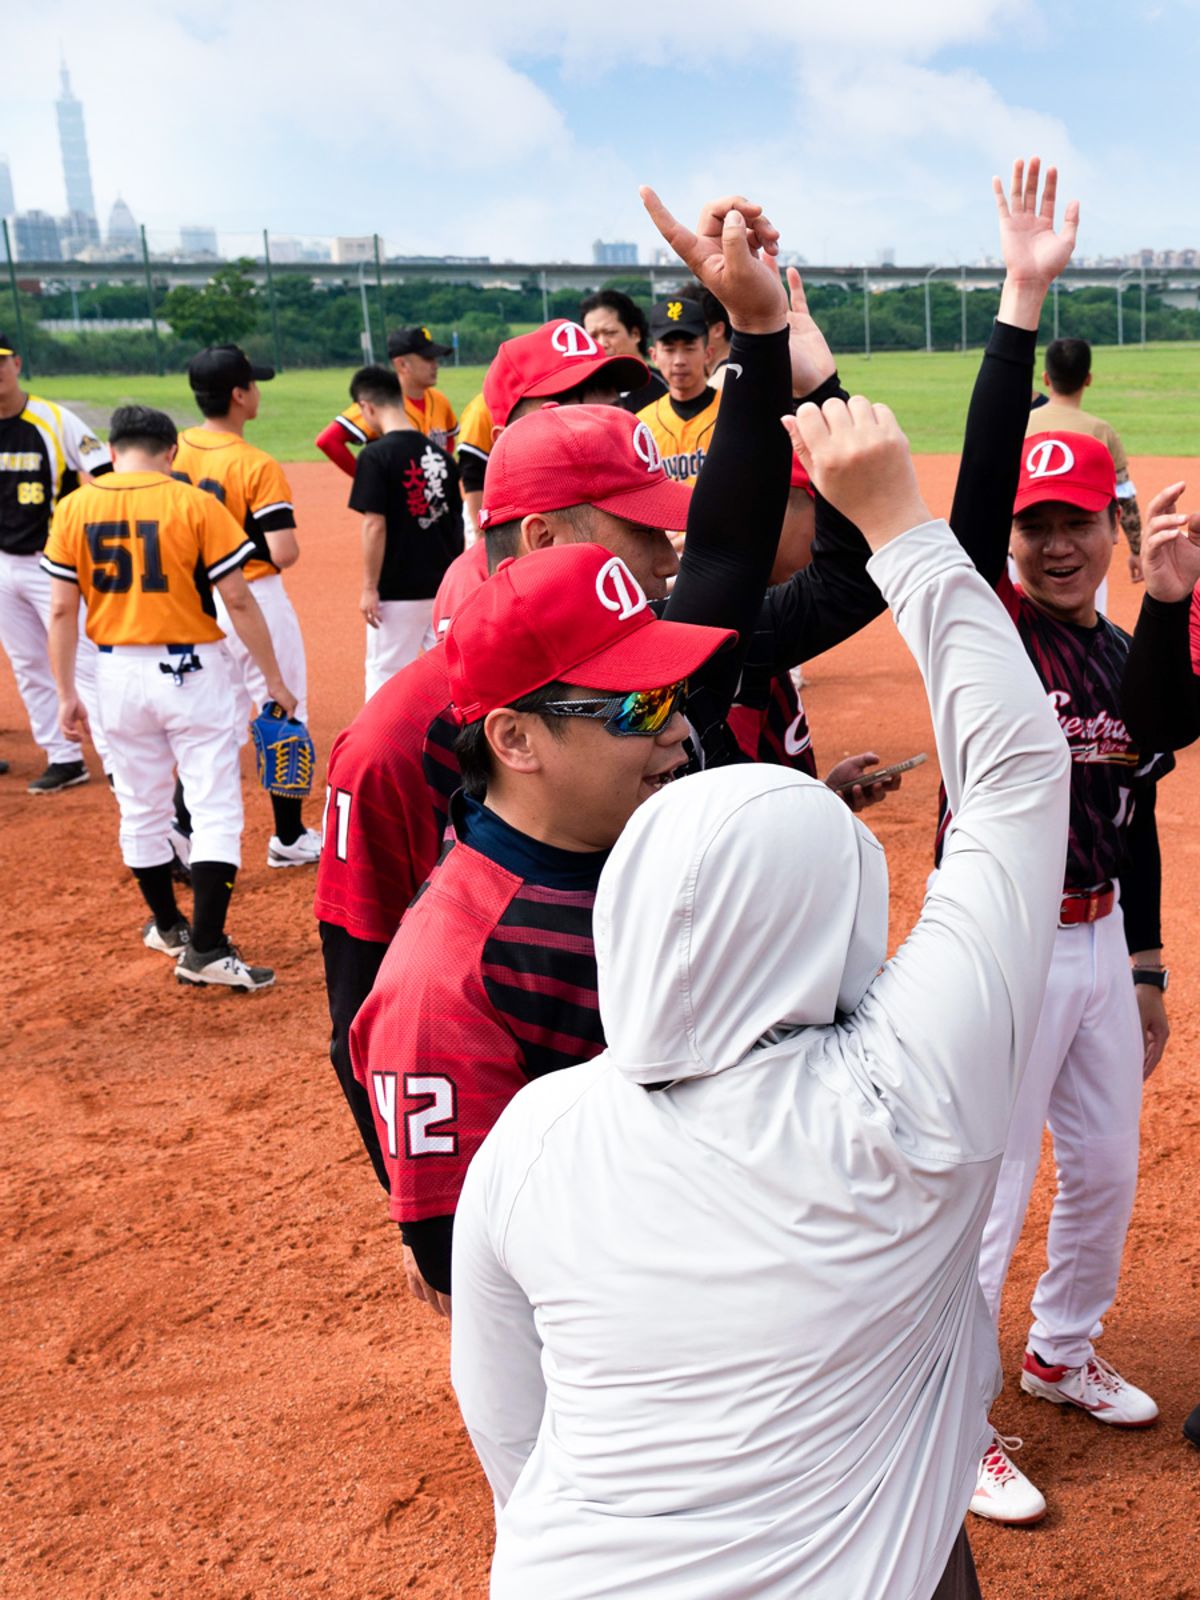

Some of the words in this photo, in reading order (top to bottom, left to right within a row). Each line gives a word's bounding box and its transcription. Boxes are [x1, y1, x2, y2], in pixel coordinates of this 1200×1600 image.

[551, 321, 598, 357] D
[632, 421, 662, 473] D
[1026, 439, 1075, 479] D
[84, 520, 169, 594] 51
[595, 556, 648, 621] D
[371, 1071, 461, 1159] 42
